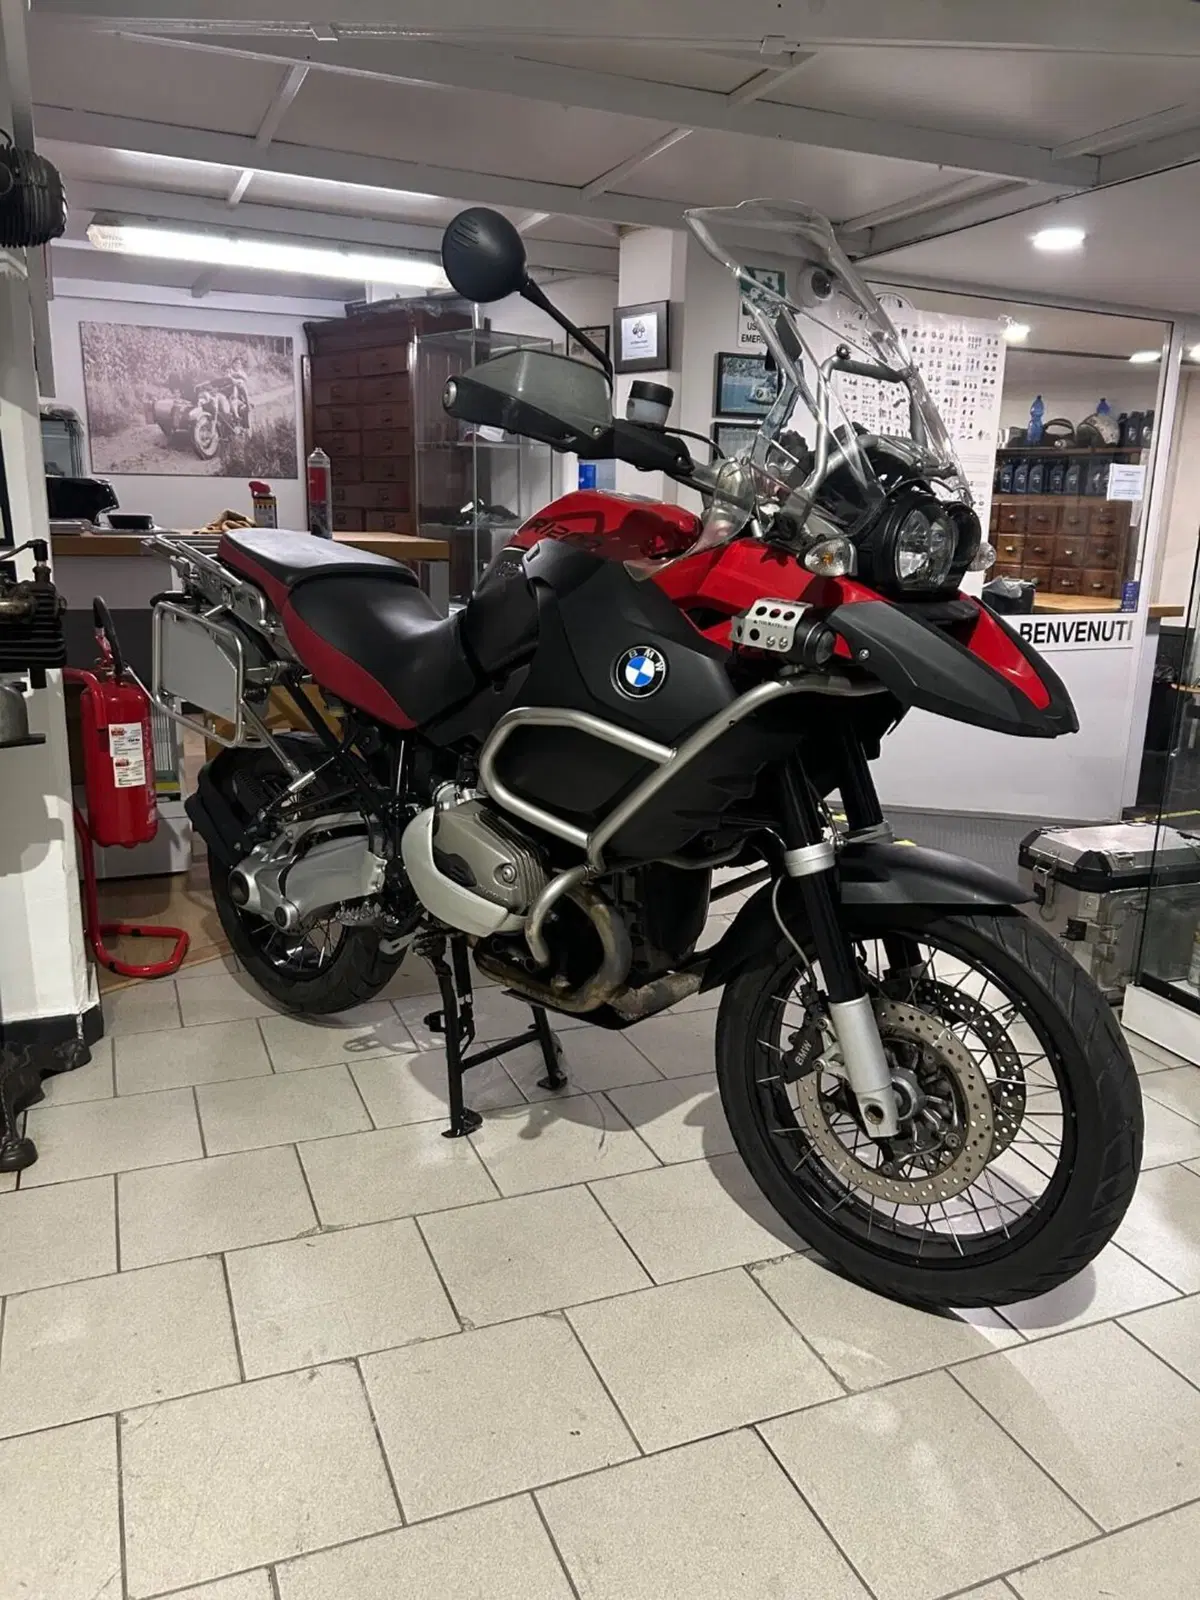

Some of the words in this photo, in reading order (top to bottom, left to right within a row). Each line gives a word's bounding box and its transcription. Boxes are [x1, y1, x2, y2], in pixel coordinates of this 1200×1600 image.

[1020, 621, 1133, 643] BENVENUTI
[628, 648, 665, 672] BMW
[795, 1040, 812, 1066] BMW
